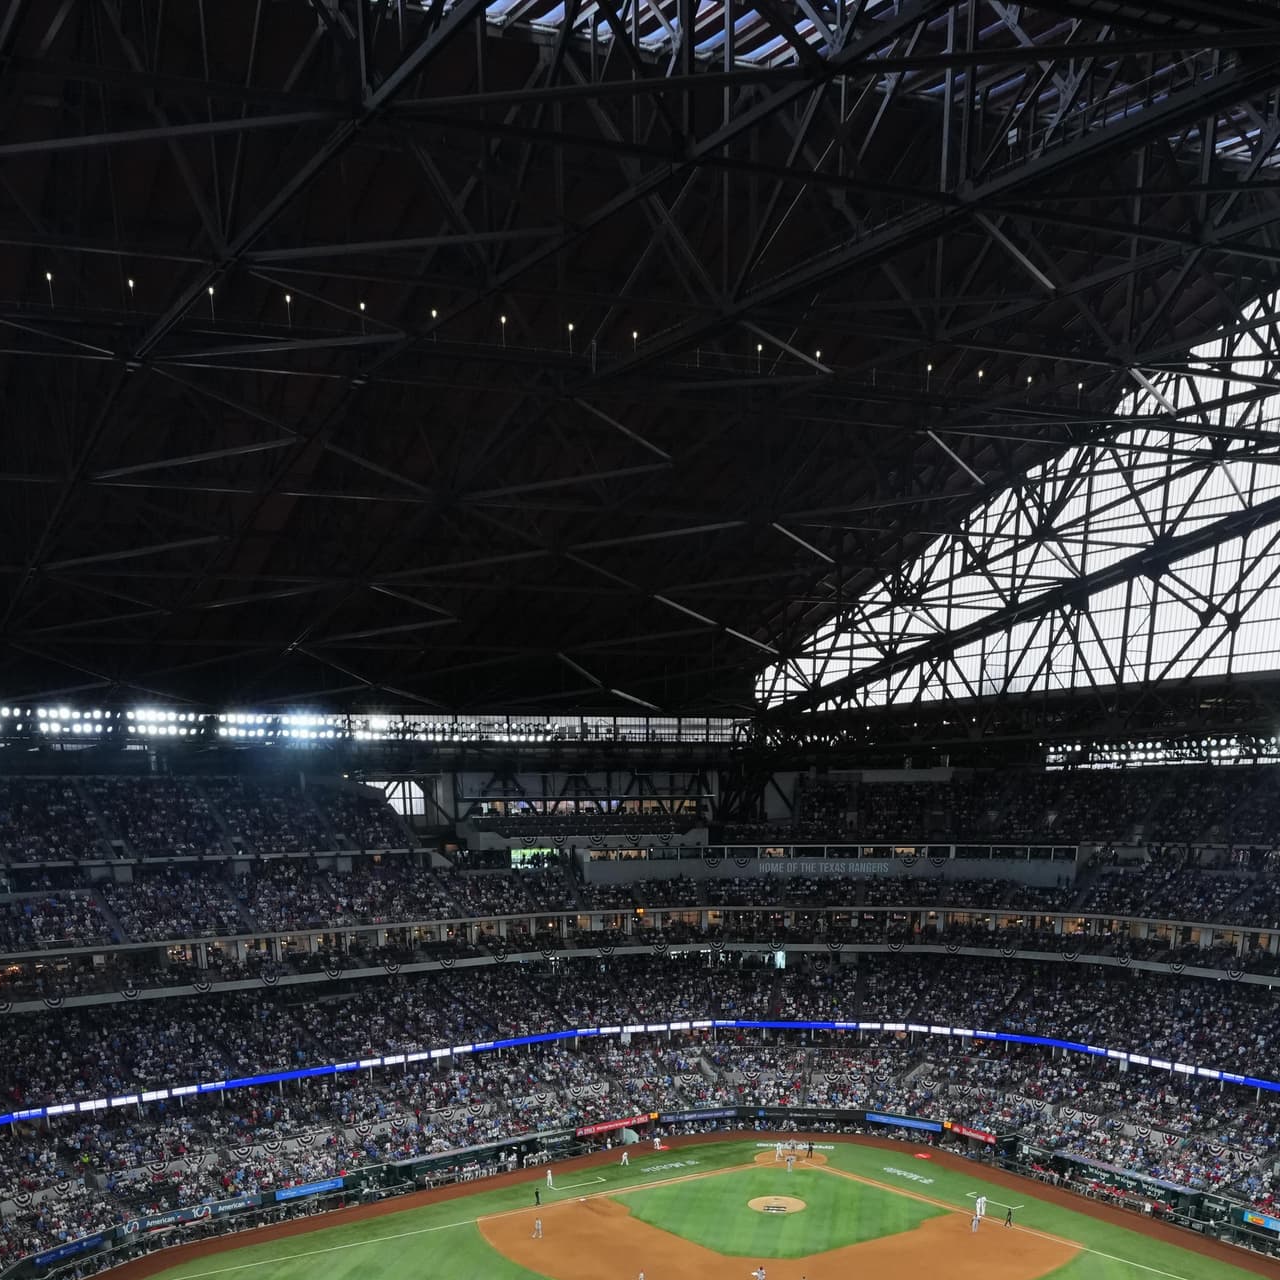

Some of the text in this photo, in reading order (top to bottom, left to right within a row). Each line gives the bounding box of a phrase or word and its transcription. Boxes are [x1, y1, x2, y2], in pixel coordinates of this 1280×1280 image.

[759, 862, 889, 873] HOME OF THE TEXAS RANGERS
[218, 1202, 246, 1213] American
[146, 1216, 176, 1228] American
